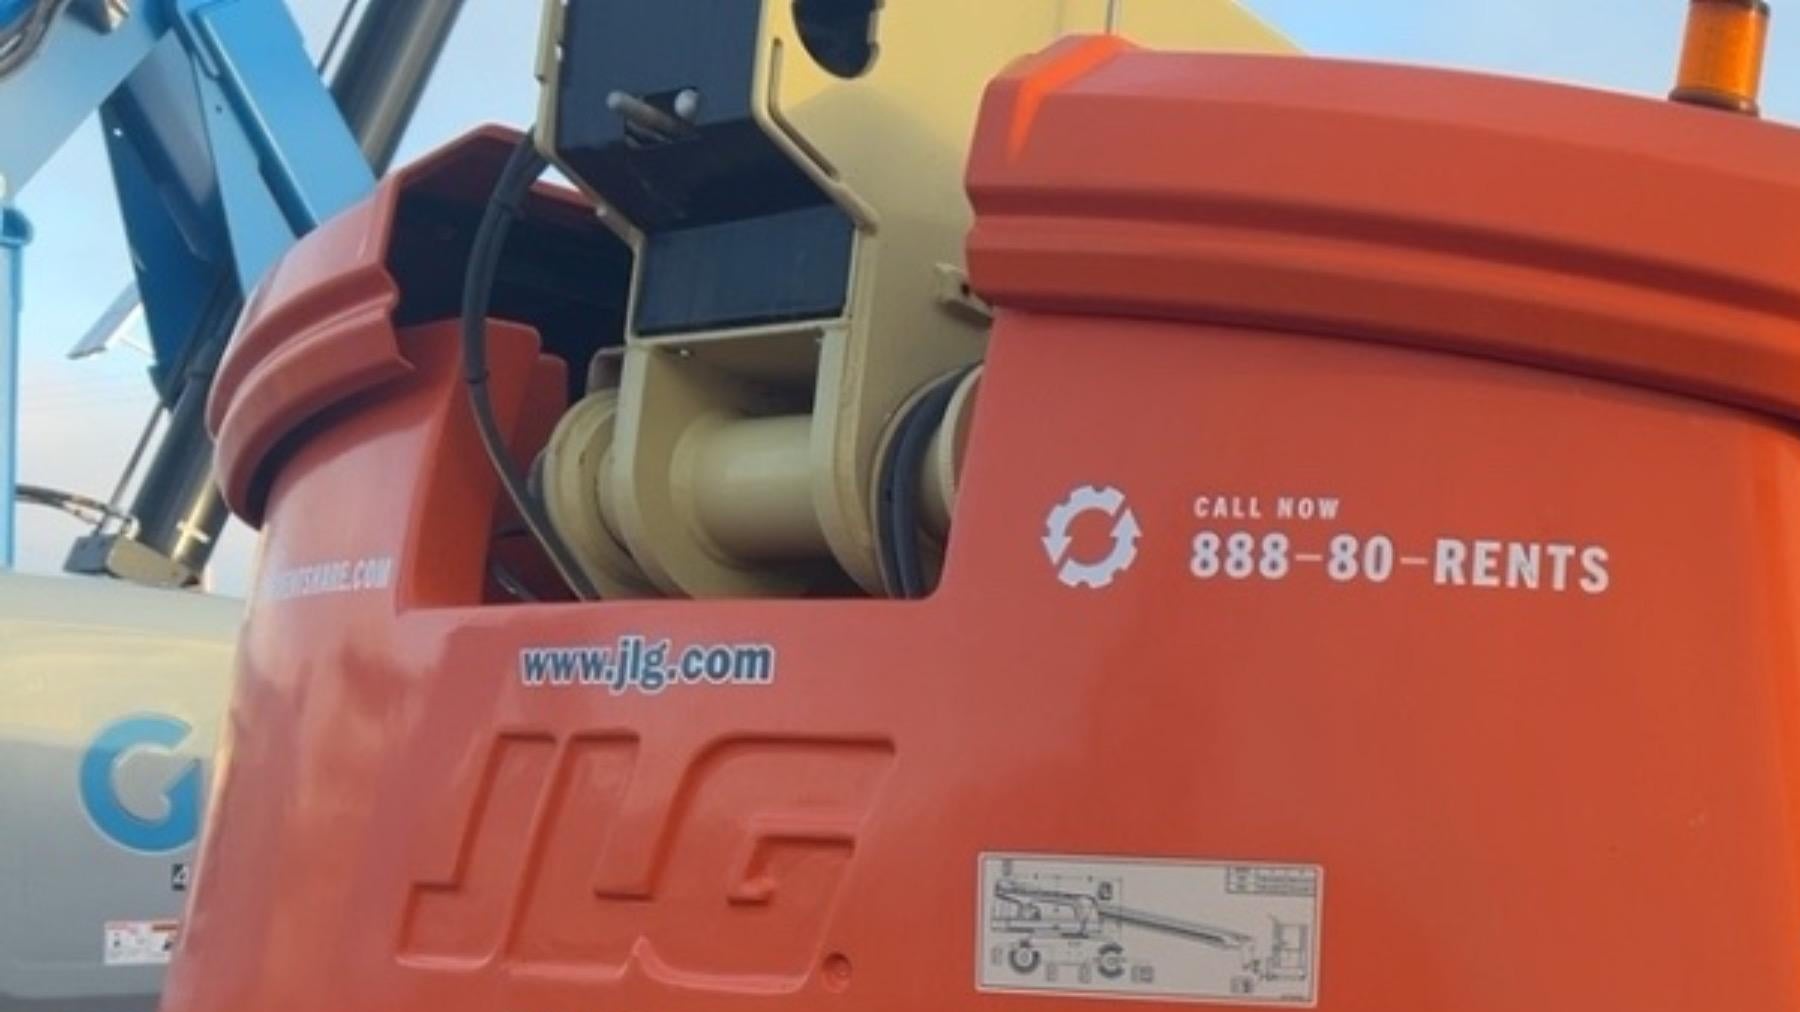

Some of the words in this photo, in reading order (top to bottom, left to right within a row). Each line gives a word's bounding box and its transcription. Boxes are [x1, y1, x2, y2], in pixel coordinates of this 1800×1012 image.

[1194, 497, 1263, 519] CALL
[1277, 498, 1341, 520] NOW
[1189, 530, 1611, 594] 888-80-RENTS
[521, 634, 774, 694] www.jlg.com
